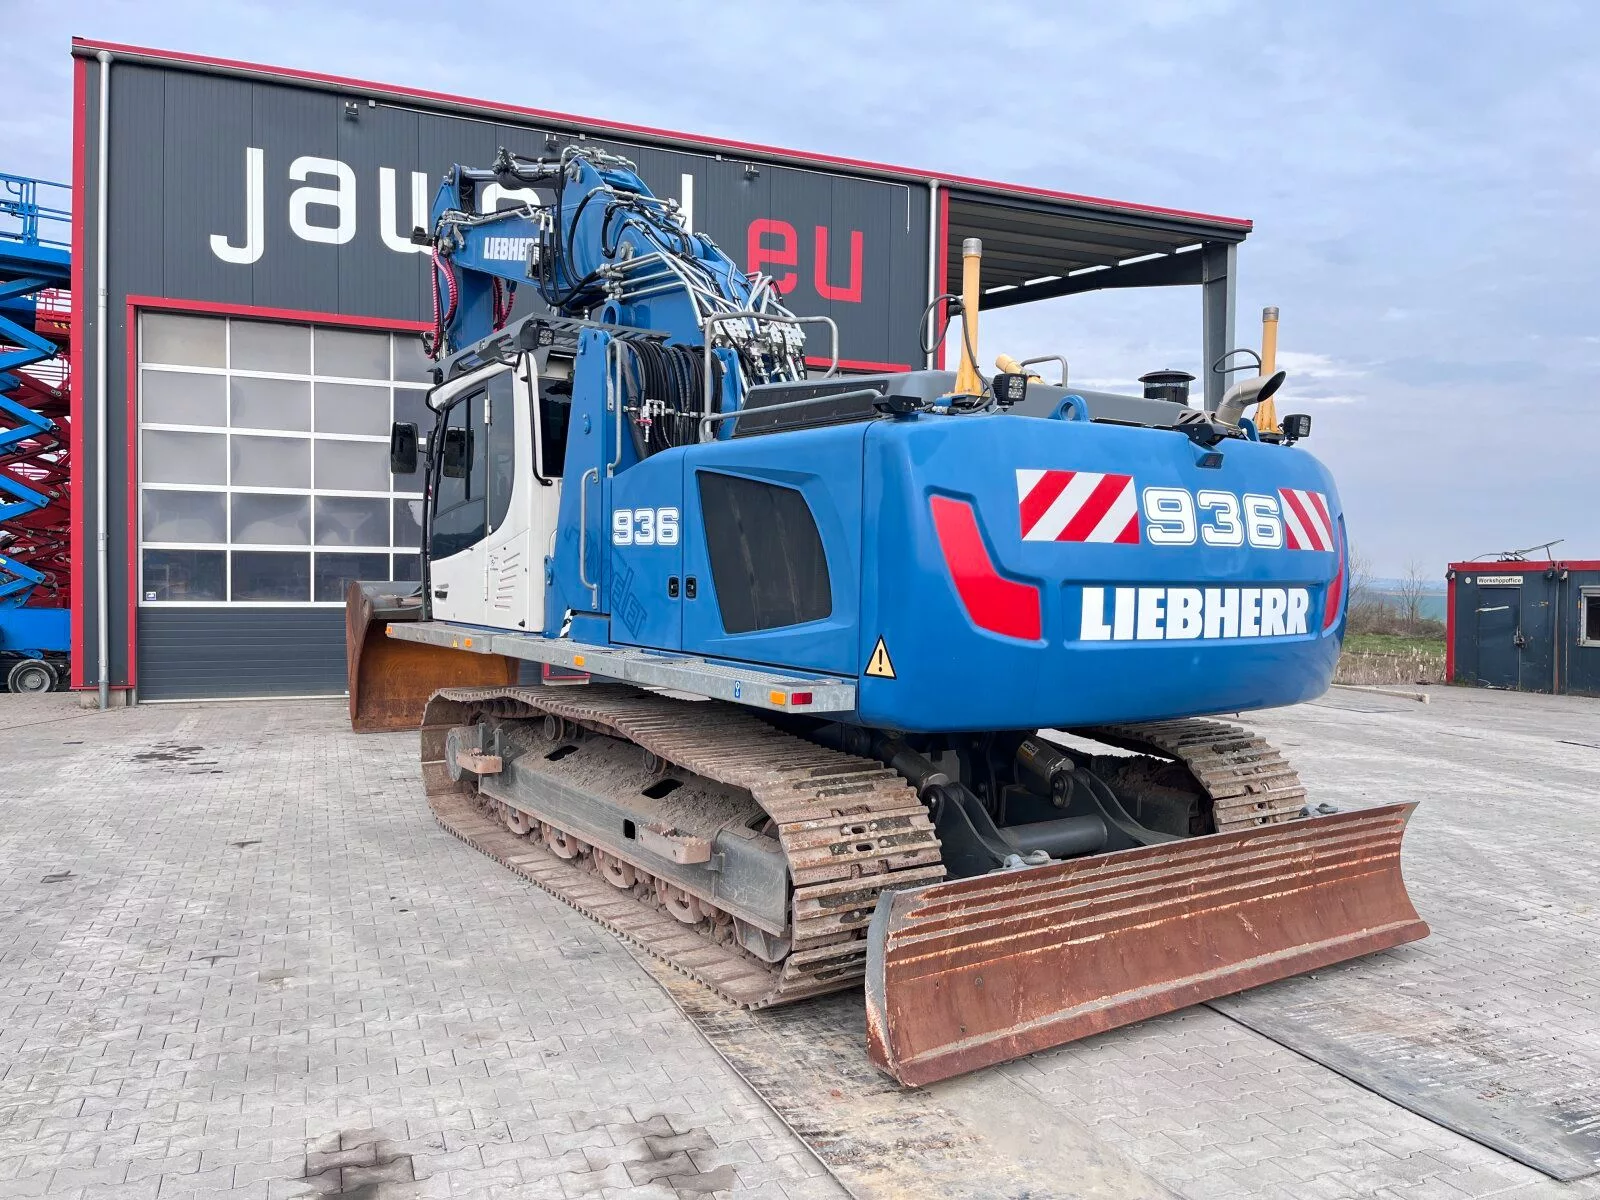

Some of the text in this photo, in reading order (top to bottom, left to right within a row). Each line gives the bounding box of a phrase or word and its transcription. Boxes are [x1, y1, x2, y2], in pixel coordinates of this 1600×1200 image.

[612, 506, 680, 546] 936
[1143, 486, 1283, 549] 936
[1079, 586, 1310, 641] LIEBHERR
